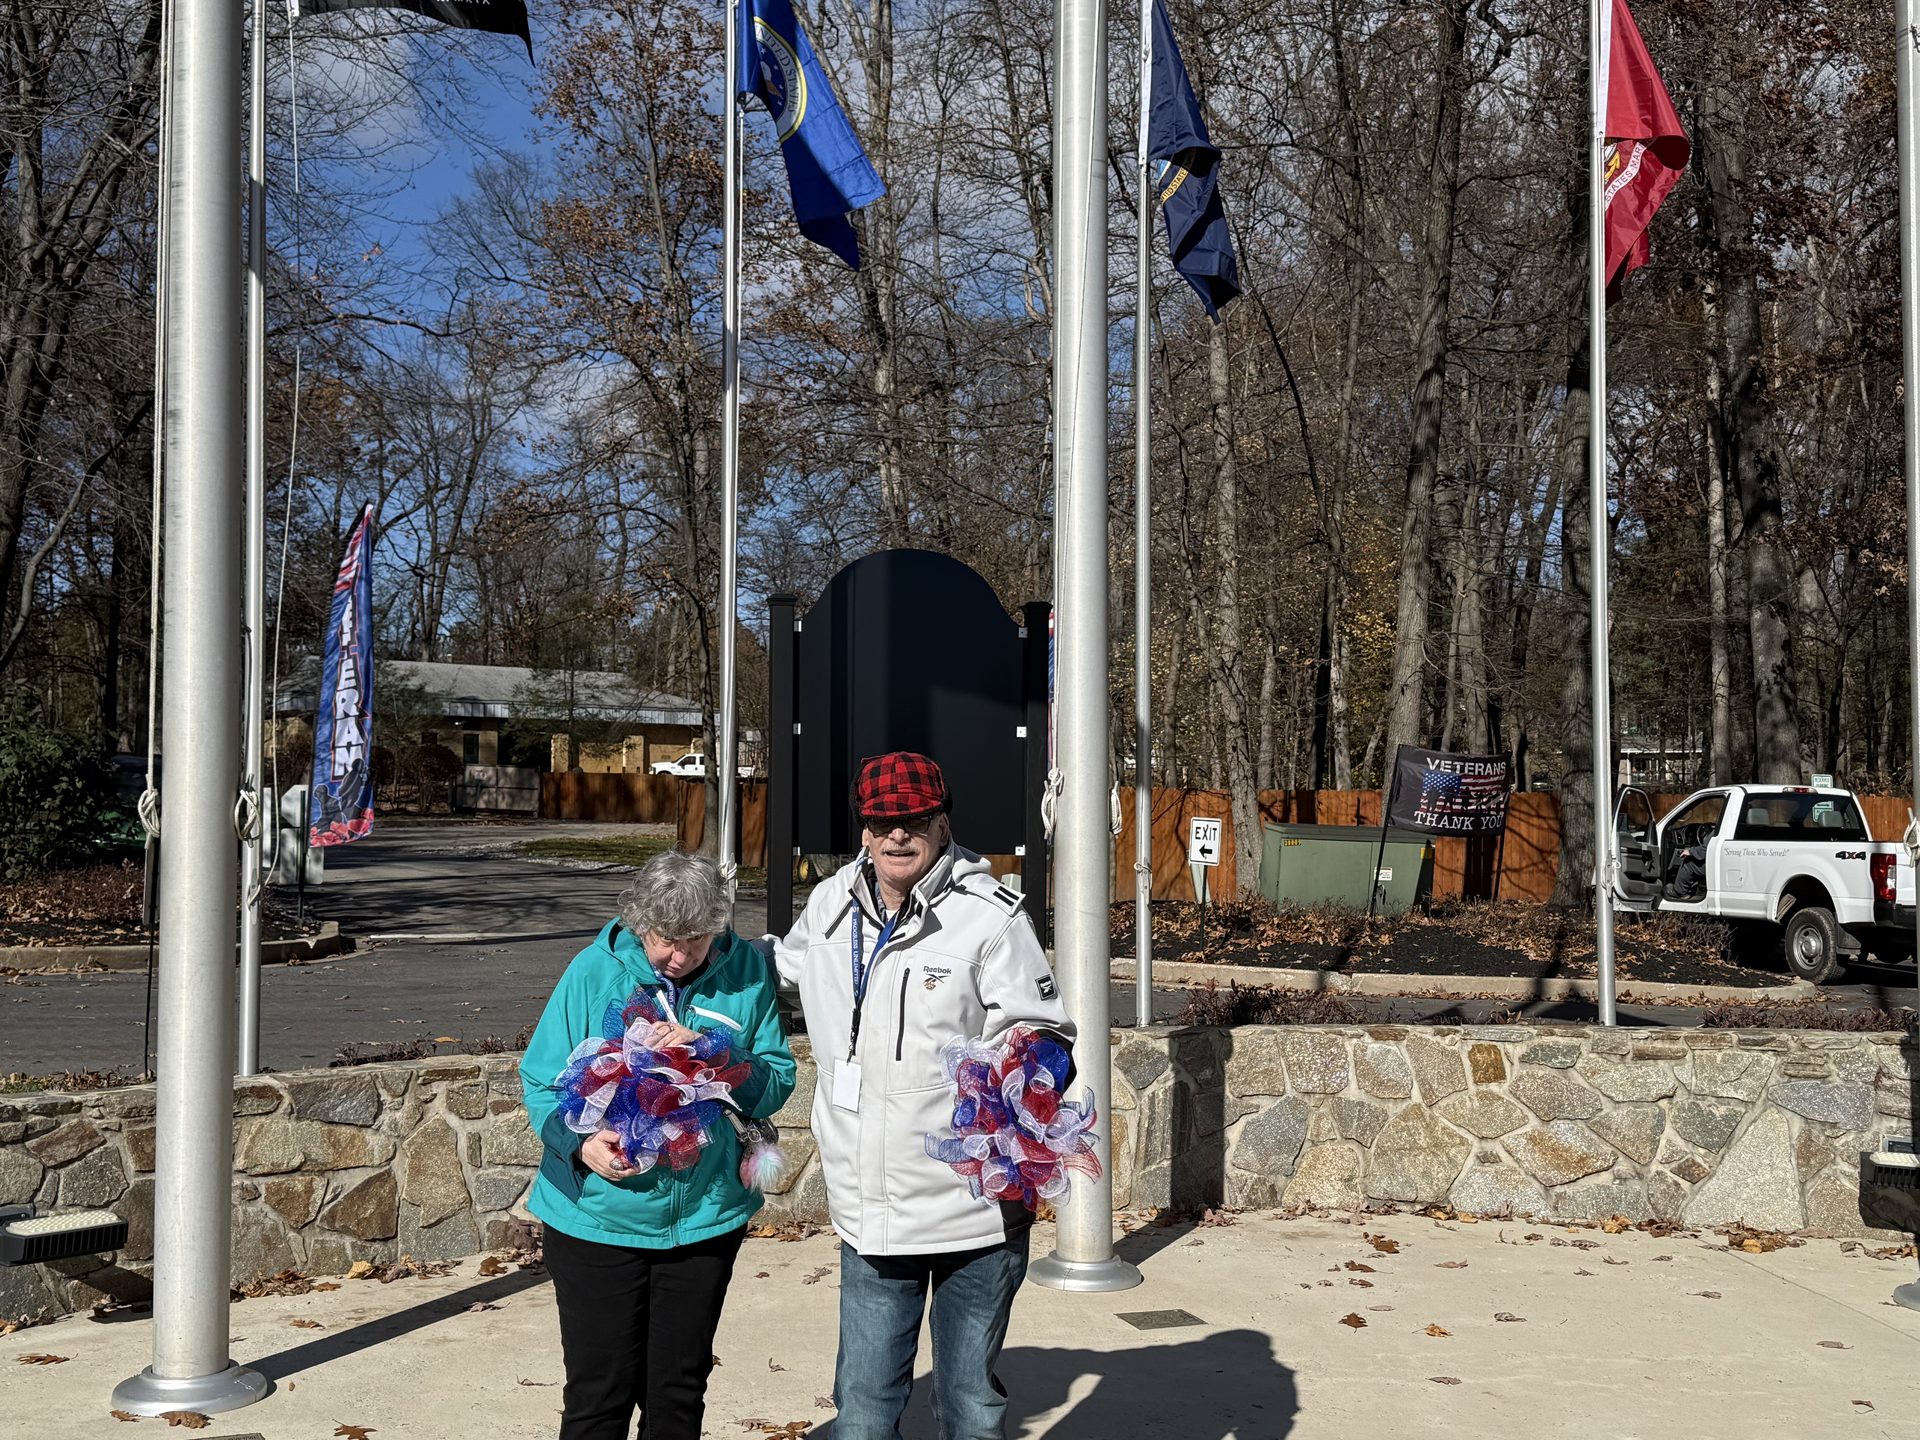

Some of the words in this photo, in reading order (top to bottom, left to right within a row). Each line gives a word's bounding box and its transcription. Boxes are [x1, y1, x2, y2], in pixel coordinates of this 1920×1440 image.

[786, 69, 799, 116] STATES
[1605, 170, 1633, 201] STATES
[1426, 757, 1507, 775] VETERANS
[1413, 810, 1475, 830] THANK
[1480, 815, 1504, 830] YOU
[1195, 825, 1217, 841] EXIT
[923, 965, 952, 975] Reebok
